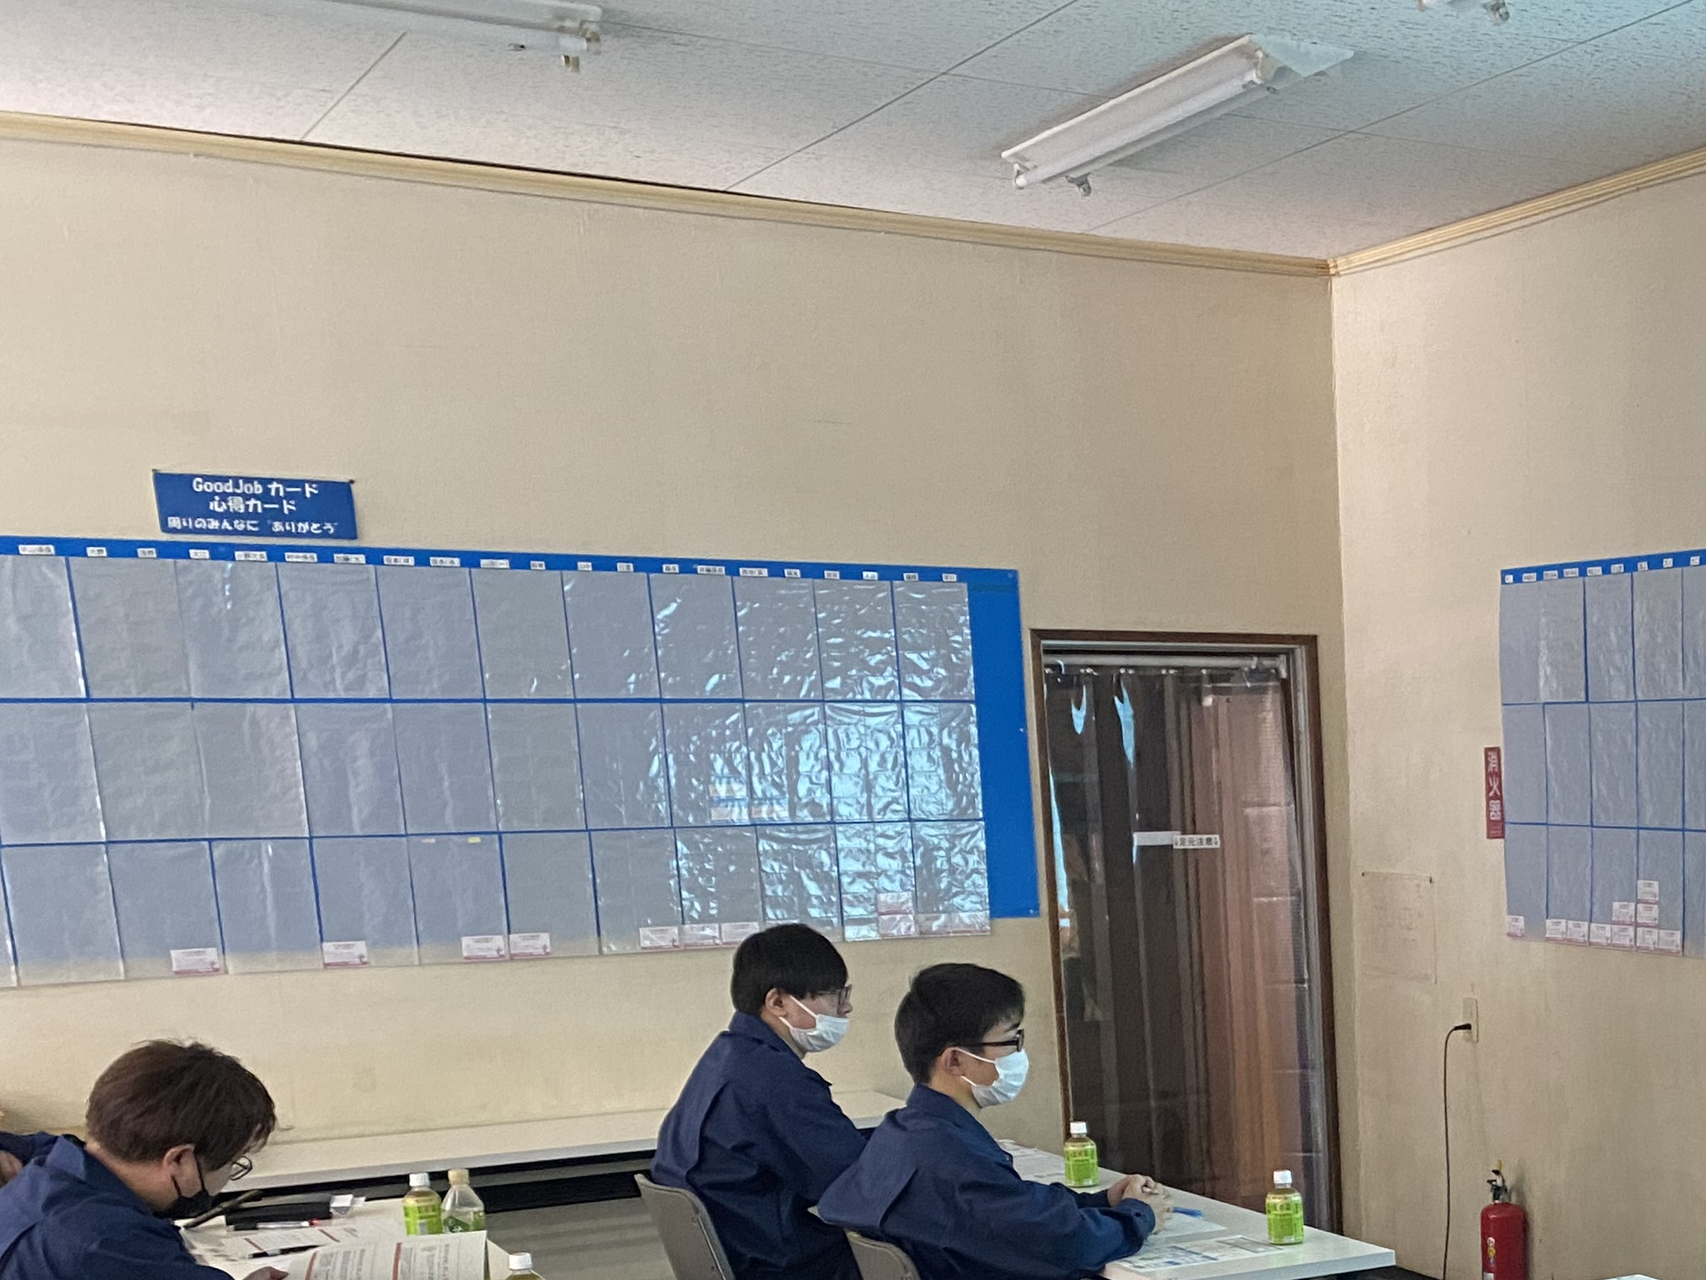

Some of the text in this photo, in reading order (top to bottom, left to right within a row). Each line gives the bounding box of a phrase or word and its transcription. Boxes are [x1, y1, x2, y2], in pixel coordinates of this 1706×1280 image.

[192, 477, 319, 498] GoodJob カード
[209, 496, 297, 514] 心得カード
[167, 516, 260, 531] 周りのみんなに
[1487, 751, 1501, 820] 消火器
